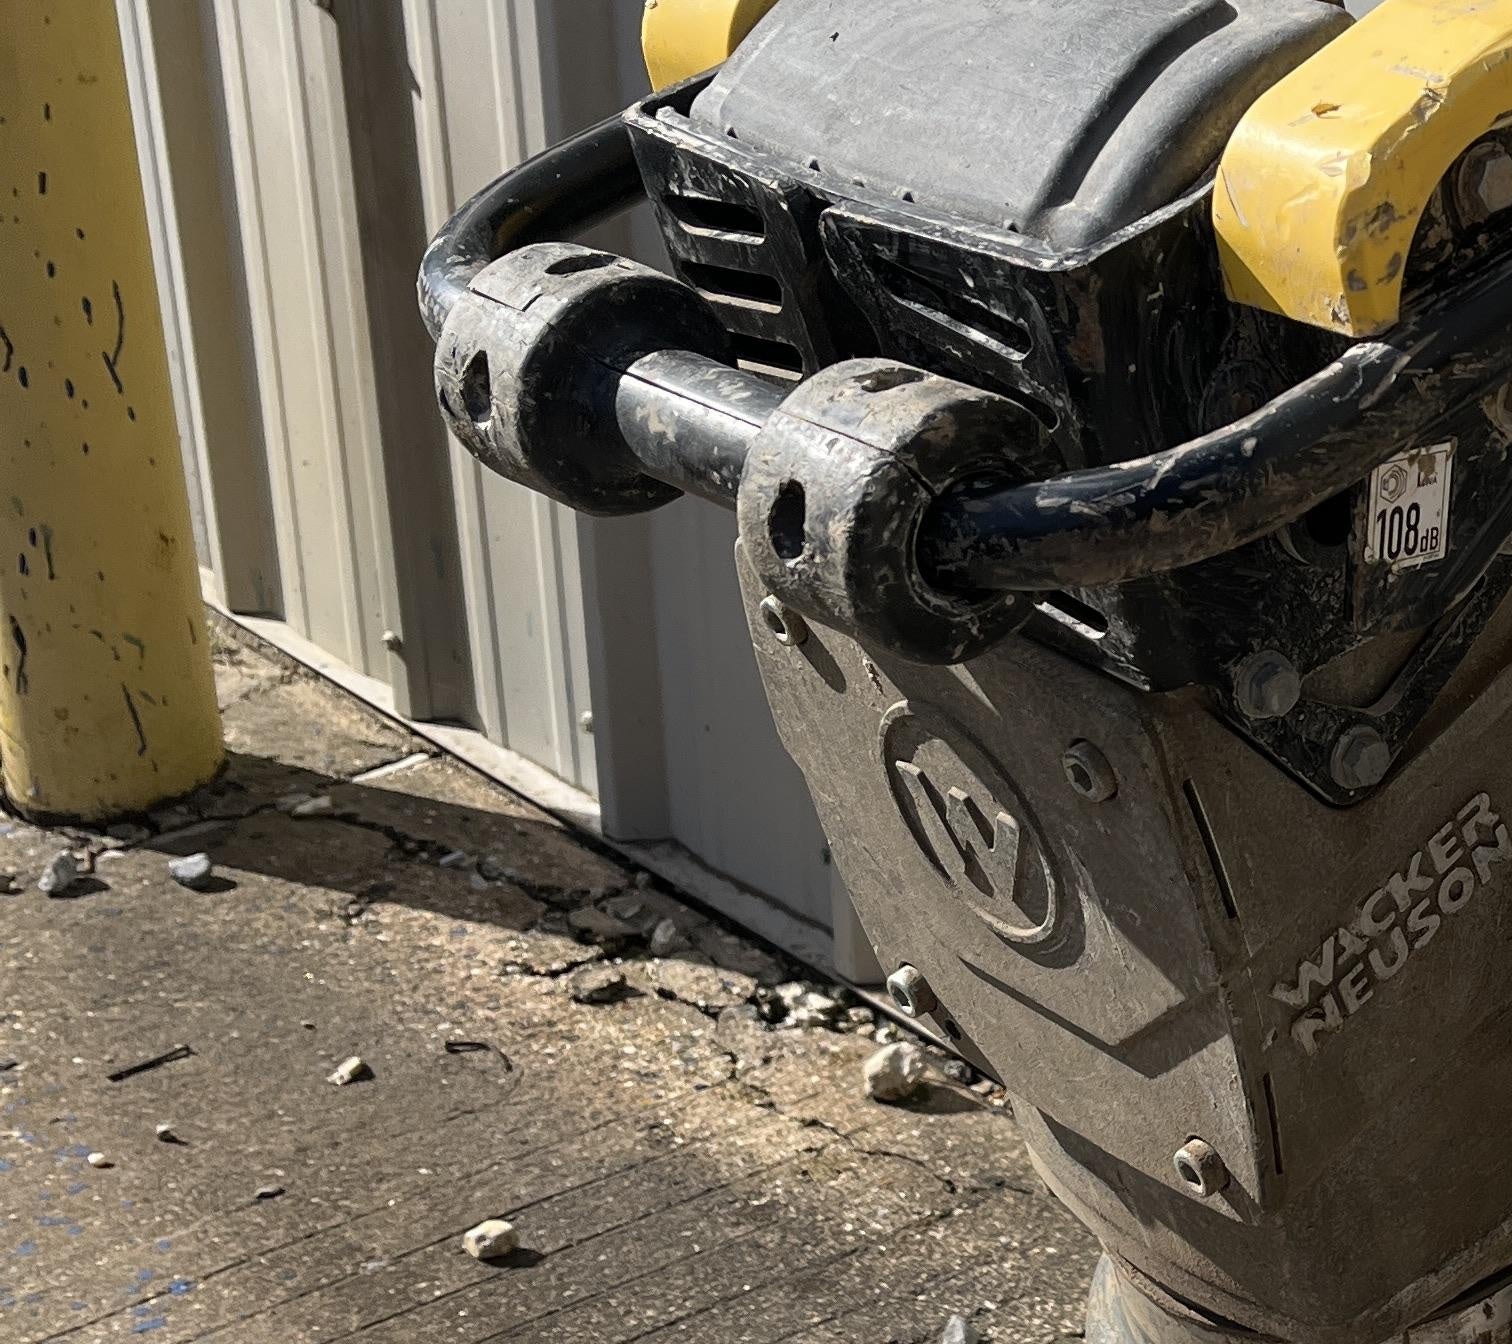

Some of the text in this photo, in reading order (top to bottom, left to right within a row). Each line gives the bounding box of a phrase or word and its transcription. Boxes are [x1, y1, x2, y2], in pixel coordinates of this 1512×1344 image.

[1376, 502, 1439, 561] 108 dB
[1269, 791, 1500, 1008] WACKER
